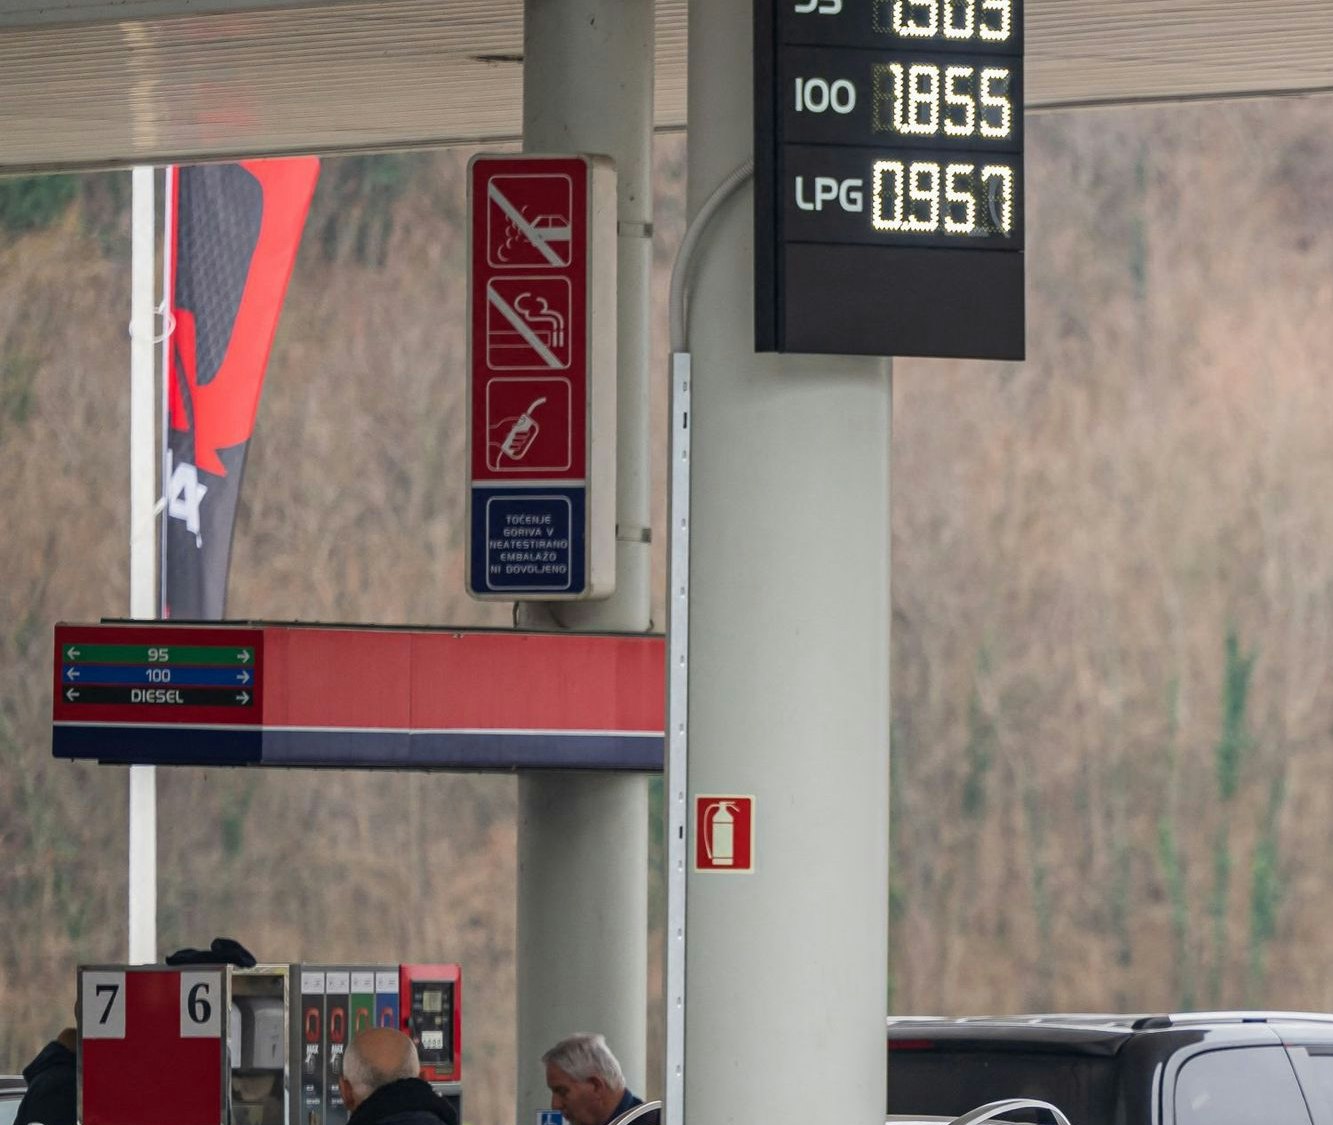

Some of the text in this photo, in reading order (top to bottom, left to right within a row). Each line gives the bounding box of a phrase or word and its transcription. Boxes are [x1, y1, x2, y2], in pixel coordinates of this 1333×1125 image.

[794, 78, 856, 113] 100
[795, 176, 864, 213] LPG
[503, 528, 554, 537] GORIVA V
[489, 540, 568, 550] NEATESTIRANO
[490, 565, 567, 574] NI DOVOLJENO
[147, 648, 169, 662] 95
[146, 668, 171, 683] 100
[131, 689, 184, 704] DIESEL
[96, 984, 120, 1024] 7
[187, 983, 211, 1024] 6
